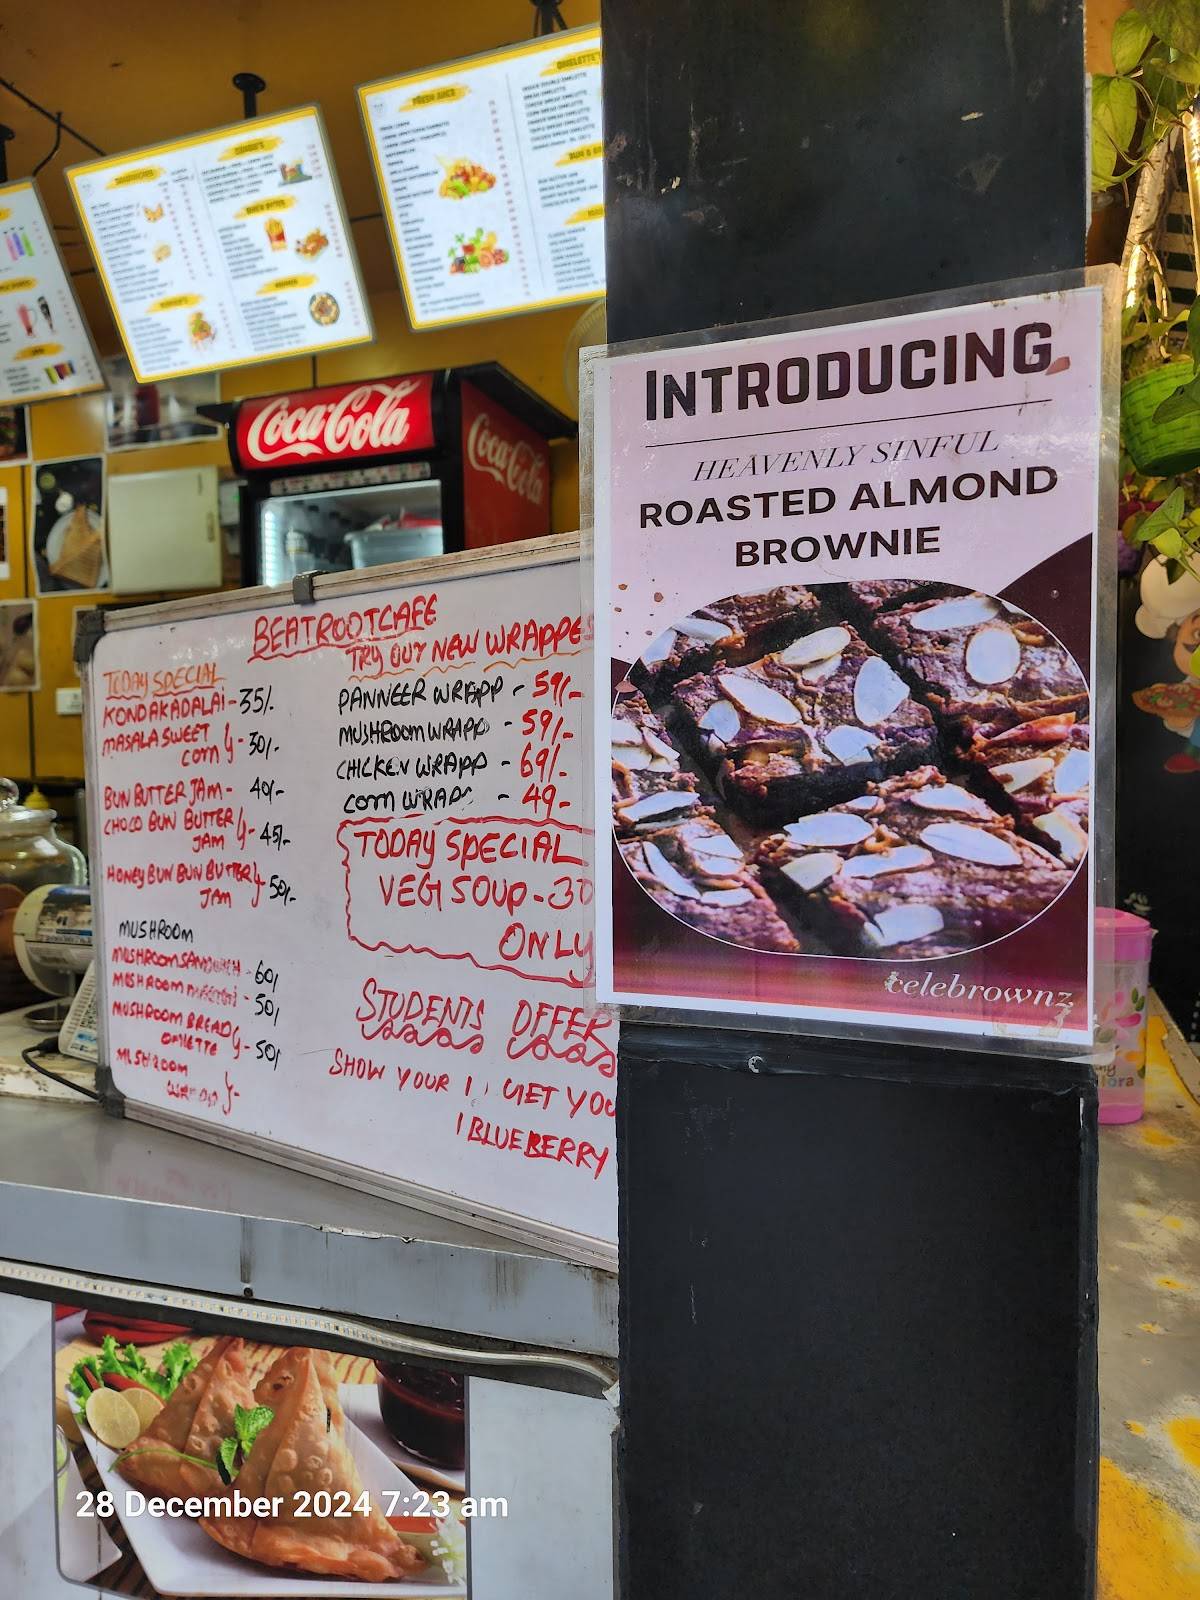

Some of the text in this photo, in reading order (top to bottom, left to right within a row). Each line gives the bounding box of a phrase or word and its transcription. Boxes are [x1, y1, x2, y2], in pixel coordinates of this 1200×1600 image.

[645, 322, 1052, 422] INTRODUCING
[691, 429, 1002, 482] HEAVENLY SINFUL
[639, 465, 1058, 529] ROASTED ALMOND
[735, 526, 942, 568] BROWNIE
[345, 645, 385, 678] TRY
[431, 628, 481, 663] NEW
[337, 676, 428, 715] PANNEER
[531, 669, 584, 708] 59/-
[102, 728, 159, 757] MASALA
[162, 722, 211, 748] SWEET
[521, 708, 574, 746] 59/-
[336, 754, 410, 781] CHICKEN
[415, 751, 489, 780] WRAPP
[519, 741, 568, 783] 69/-
[103, 785, 131, 811] BUN
[133, 780, 188, 807] BUTTER
[189, 776, 224, 808] JAM
[249, 776, 286, 806] 40/-
[103, 815, 144, 836] CHOCO
[148, 809, 178, 833] BUN
[183, 806, 234, 832] BUTTER
[191, 832, 226, 854] JAM
[353, 828, 590, 871] TODAY SPECIAL
[106, 857, 298, 907] HONEY BUN BUN BUTTER 50/-
[199, 887, 233, 909] JAM
[118, 918, 195, 944] MUSHROOM
[112, 970, 184, 995] MUSHROOM
[111, 1000, 183, 1027] MUSHROOM
[186, 1010, 233, 1039] BREAD
[356, 977, 613, 1045] STUDENTS OFFER
[329, 1047, 386, 1081] SHOW
[397, 1066, 450, 1093] YOUR
[502, 1077, 560, 1111] GET
[467, 1115, 610, 1181] BLUEBERRY
